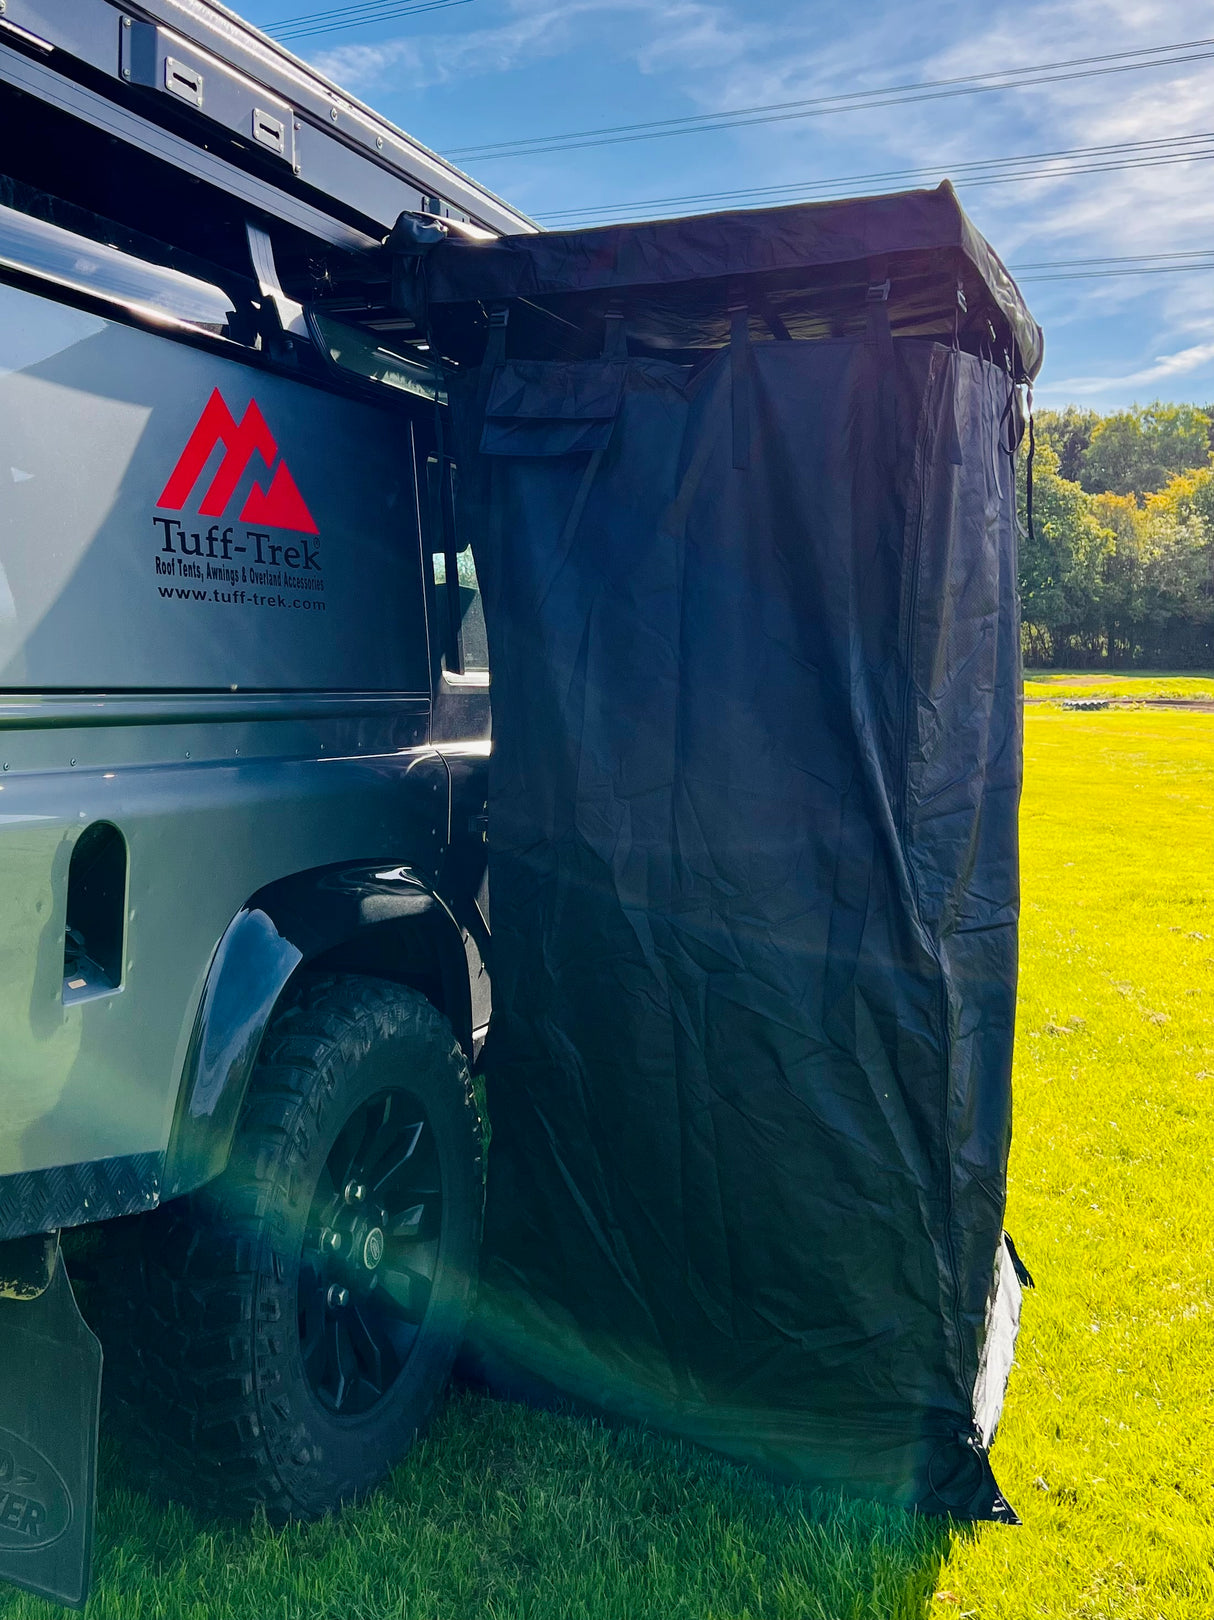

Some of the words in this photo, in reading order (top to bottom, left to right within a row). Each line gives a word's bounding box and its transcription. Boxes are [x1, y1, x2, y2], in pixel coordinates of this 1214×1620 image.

[155, 556, 175, 576] Roof
[177, 559, 205, 582] Tents,
[206, 562, 240, 586] Awnings
[241, 566, 248, 583] &
[249, 567, 282, 587] Overland
[283, 571, 325, 591] Accessories
[157, 586, 326, 611] www.tuff-trek.com
